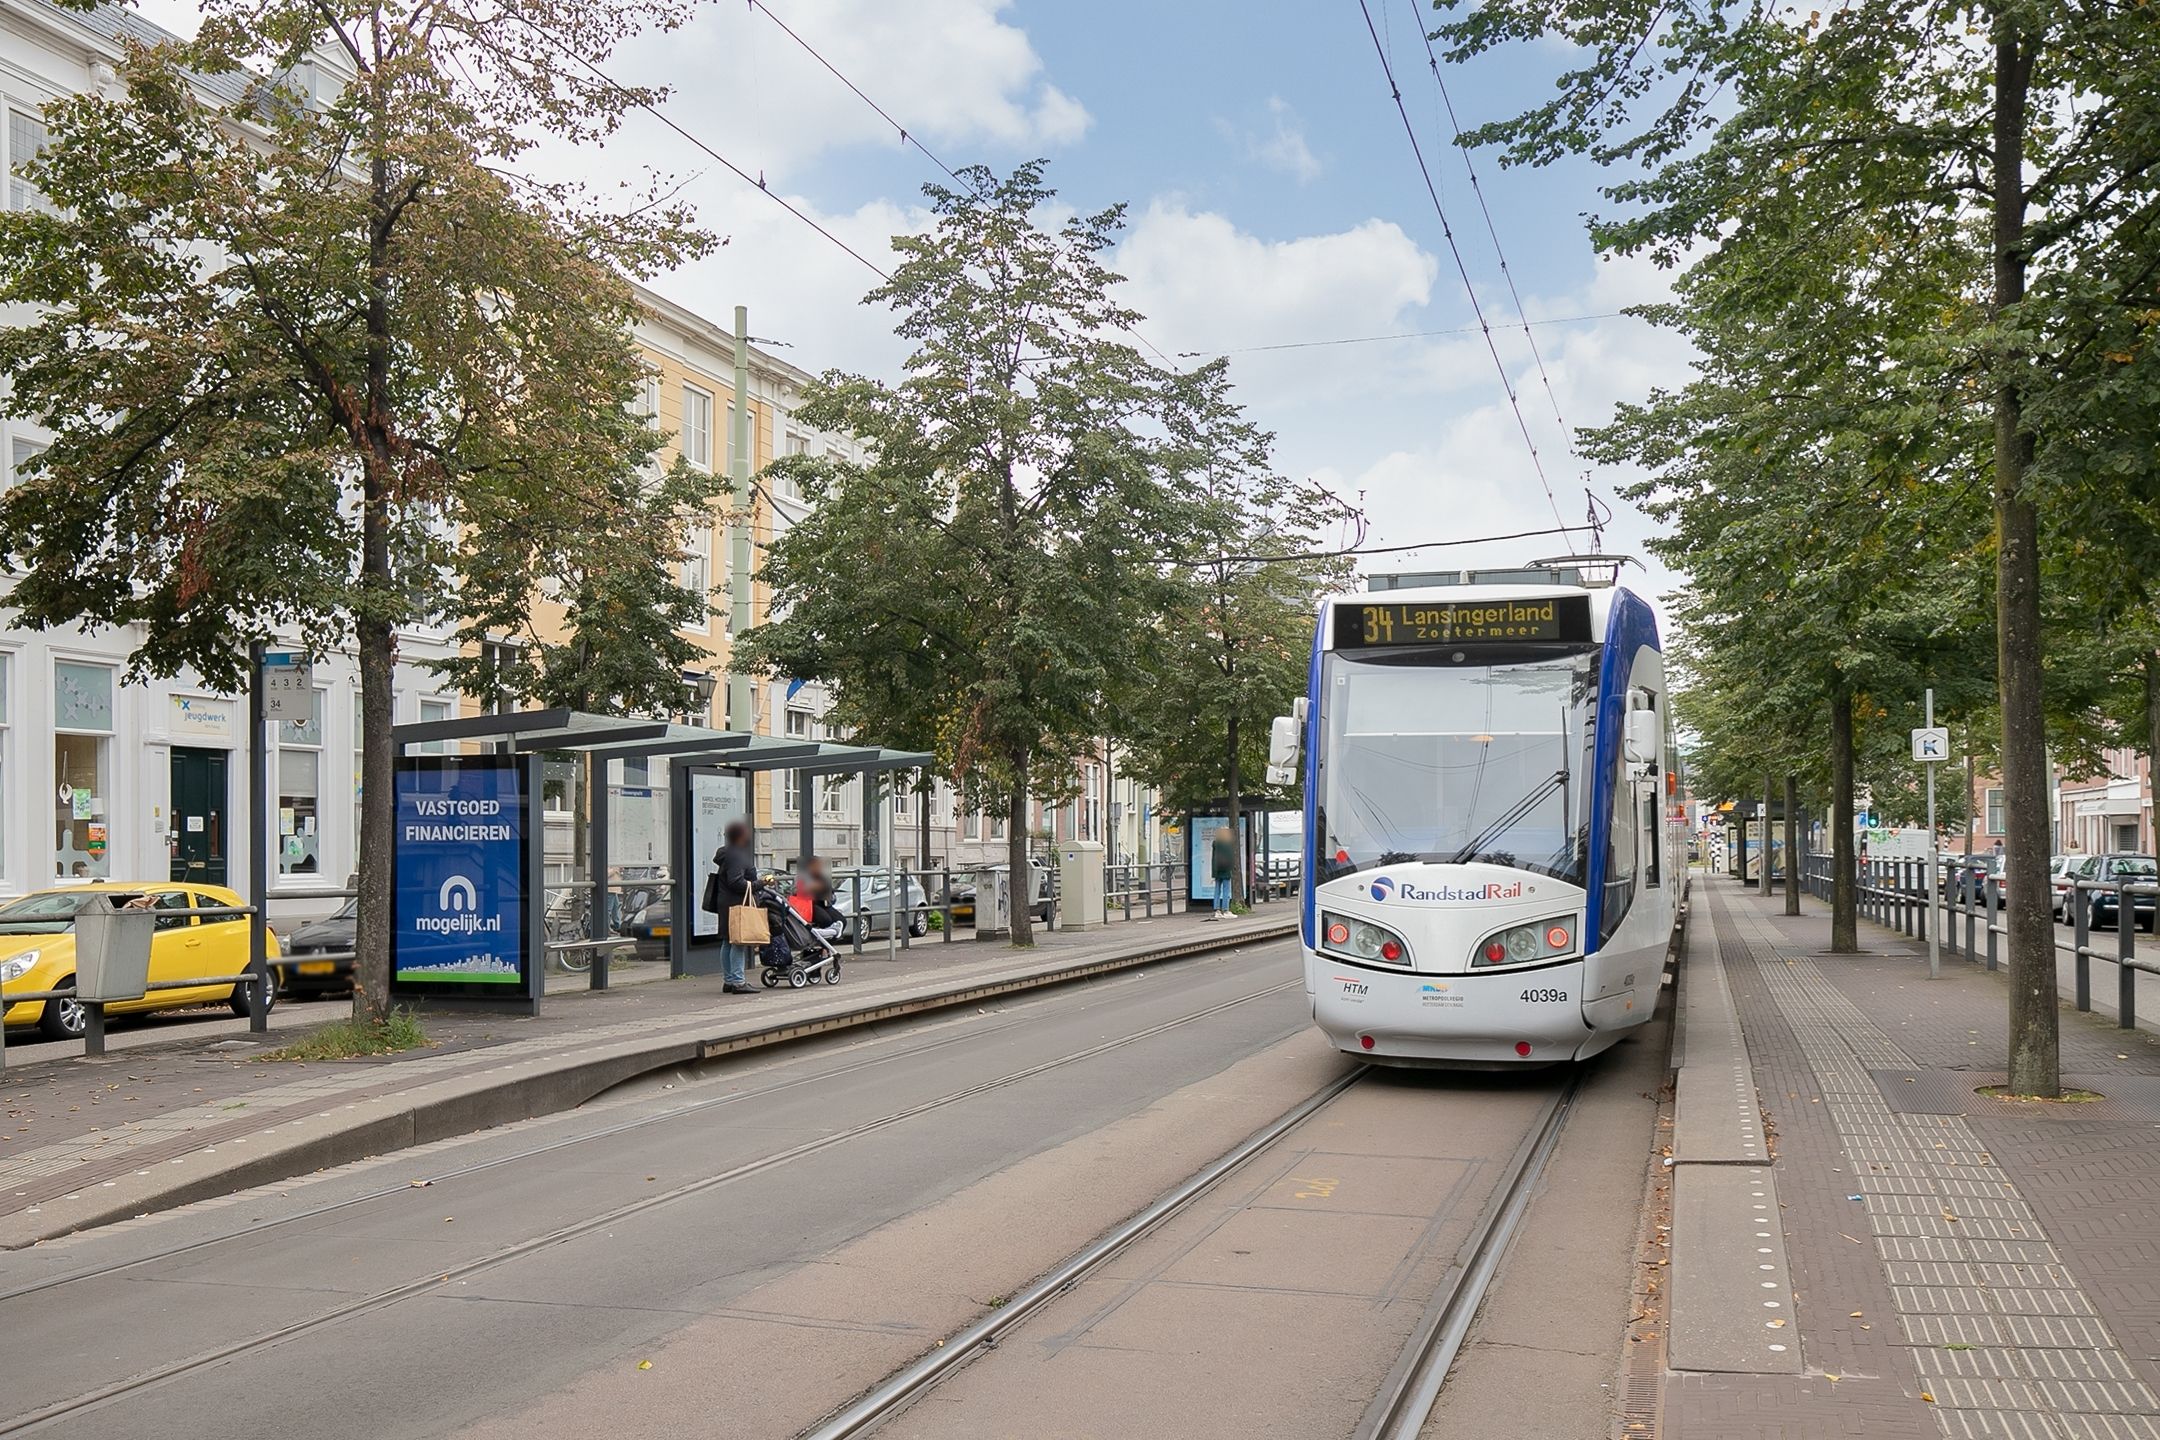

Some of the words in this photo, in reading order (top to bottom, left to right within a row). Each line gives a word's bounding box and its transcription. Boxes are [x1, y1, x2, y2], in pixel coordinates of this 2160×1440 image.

[1363, 606, 1394, 643] 34
[1402, 600, 1554, 626] Lansingerland
[1416, 626, 1540, 639] Zoetermeer
[270, 679, 277, 687] 4
[283, 678, 290, 687] 3
[296, 678, 303, 687] 2
[270, 699, 281, 708] 34
[184, 712, 226, 722] jeugdwerk
[415, 800, 500, 816] VASTGOED
[405, 825, 510, 841] FINANCIEREN
[1401, 881, 1521, 900] RandstadRail
[416, 913, 501, 936] mogelijk.nl
[1343, 983, 1369, 995] HTM
[1519, 988, 1568, 1003] 4039a
